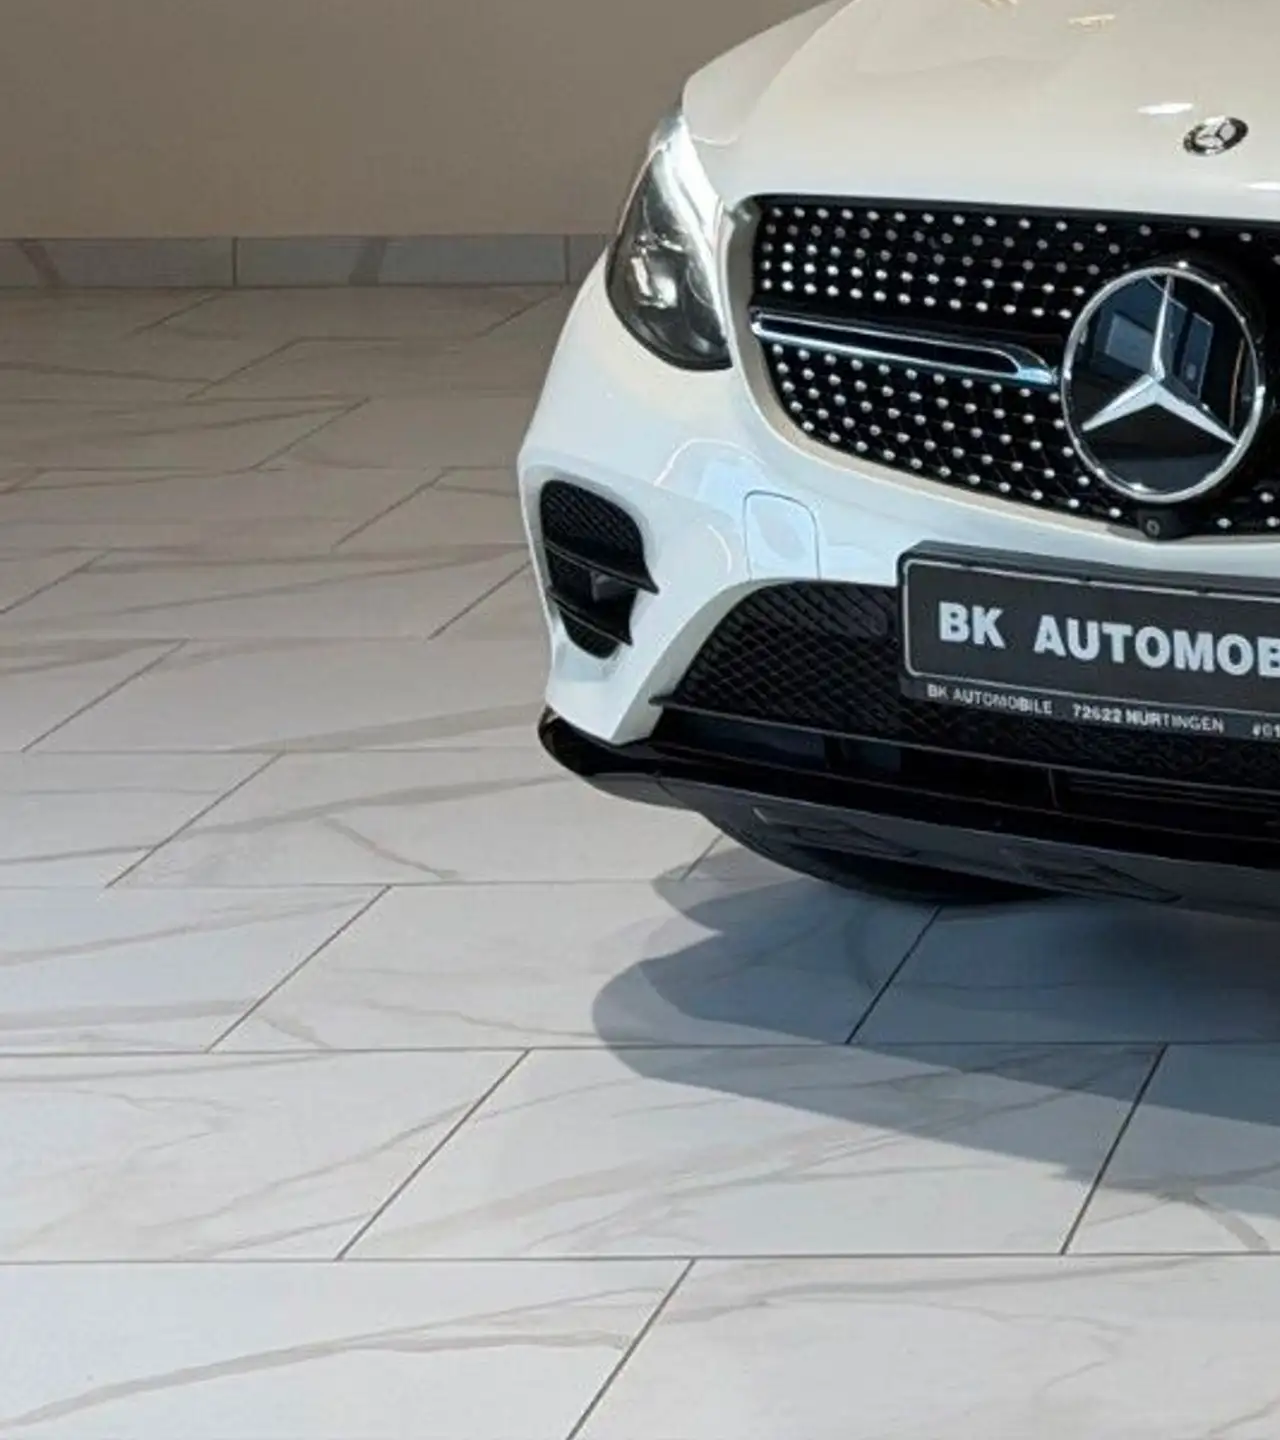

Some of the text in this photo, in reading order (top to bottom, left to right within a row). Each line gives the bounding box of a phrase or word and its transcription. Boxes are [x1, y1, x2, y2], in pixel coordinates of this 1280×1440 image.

[938, 601, 1004, 648] BK
[926, 683, 949, 701] BK
[952, 688, 1053, 715] AUTOMOBILE
